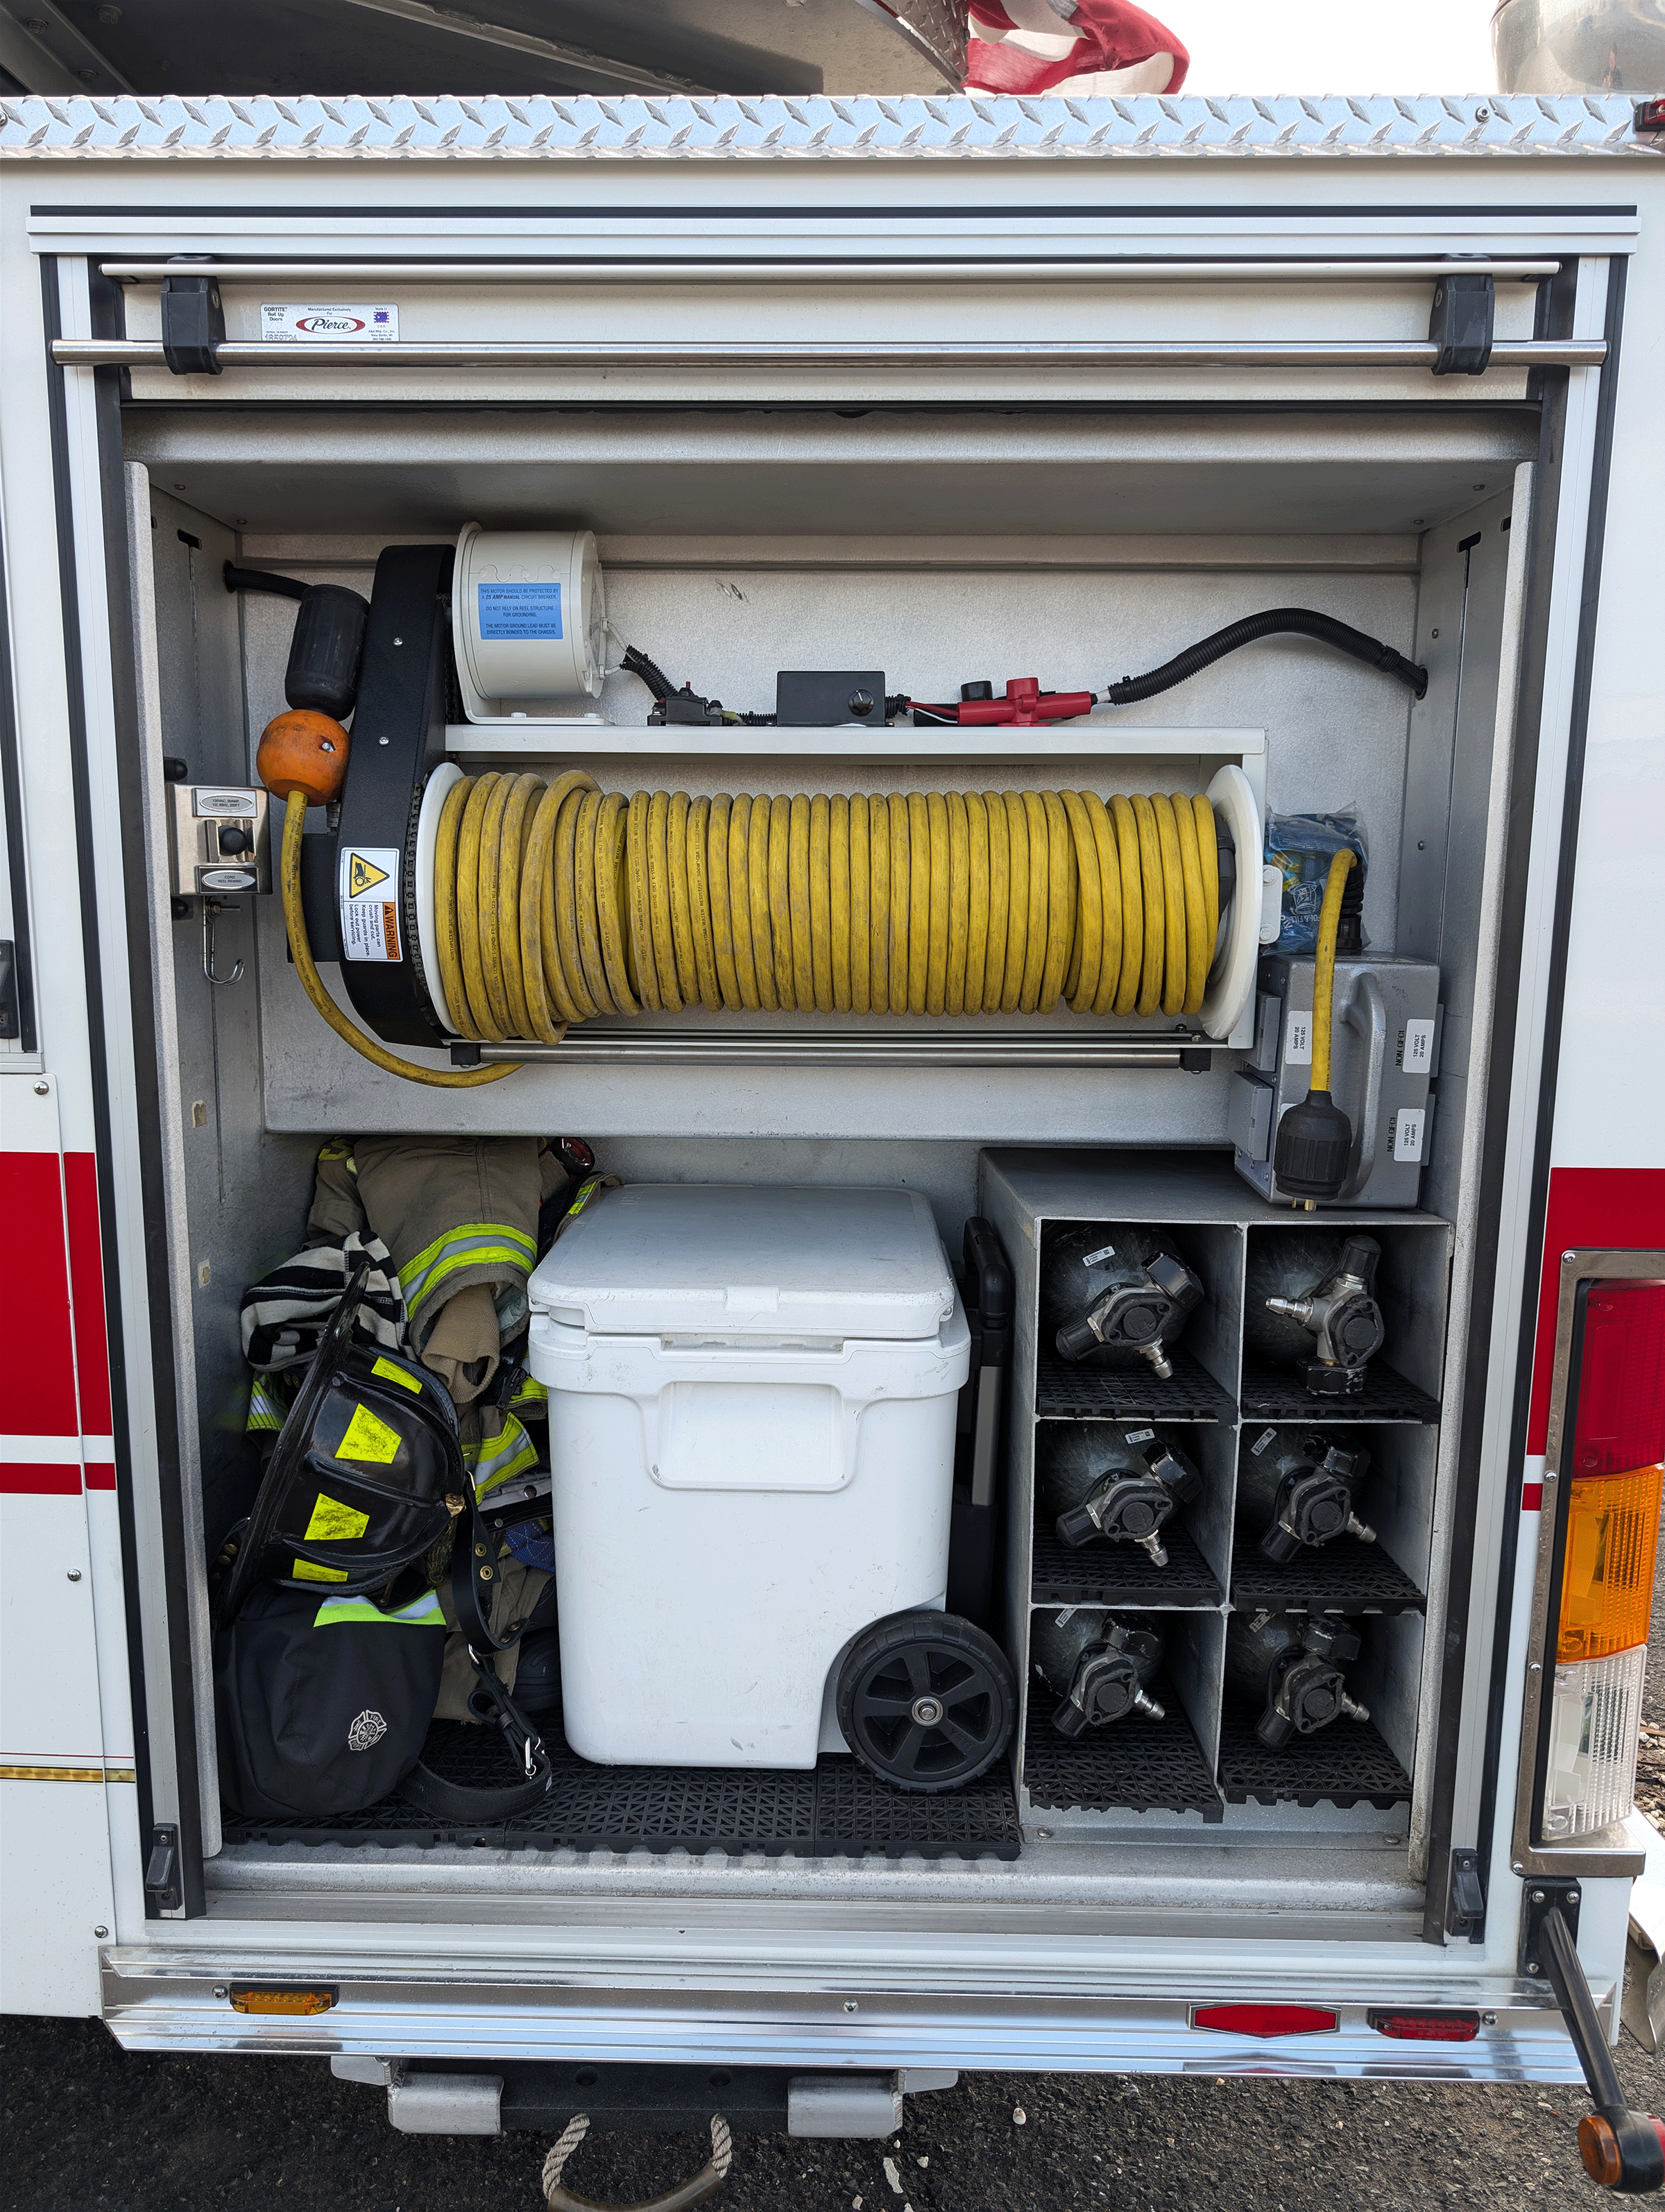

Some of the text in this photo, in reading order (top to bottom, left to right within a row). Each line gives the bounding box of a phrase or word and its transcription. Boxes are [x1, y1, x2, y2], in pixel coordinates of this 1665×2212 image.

[384, 916, 398, 958] WARNING
[1386, 1117, 1396, 1152] NON GFCI
[370, 1715, 382, 1725] FIRE
